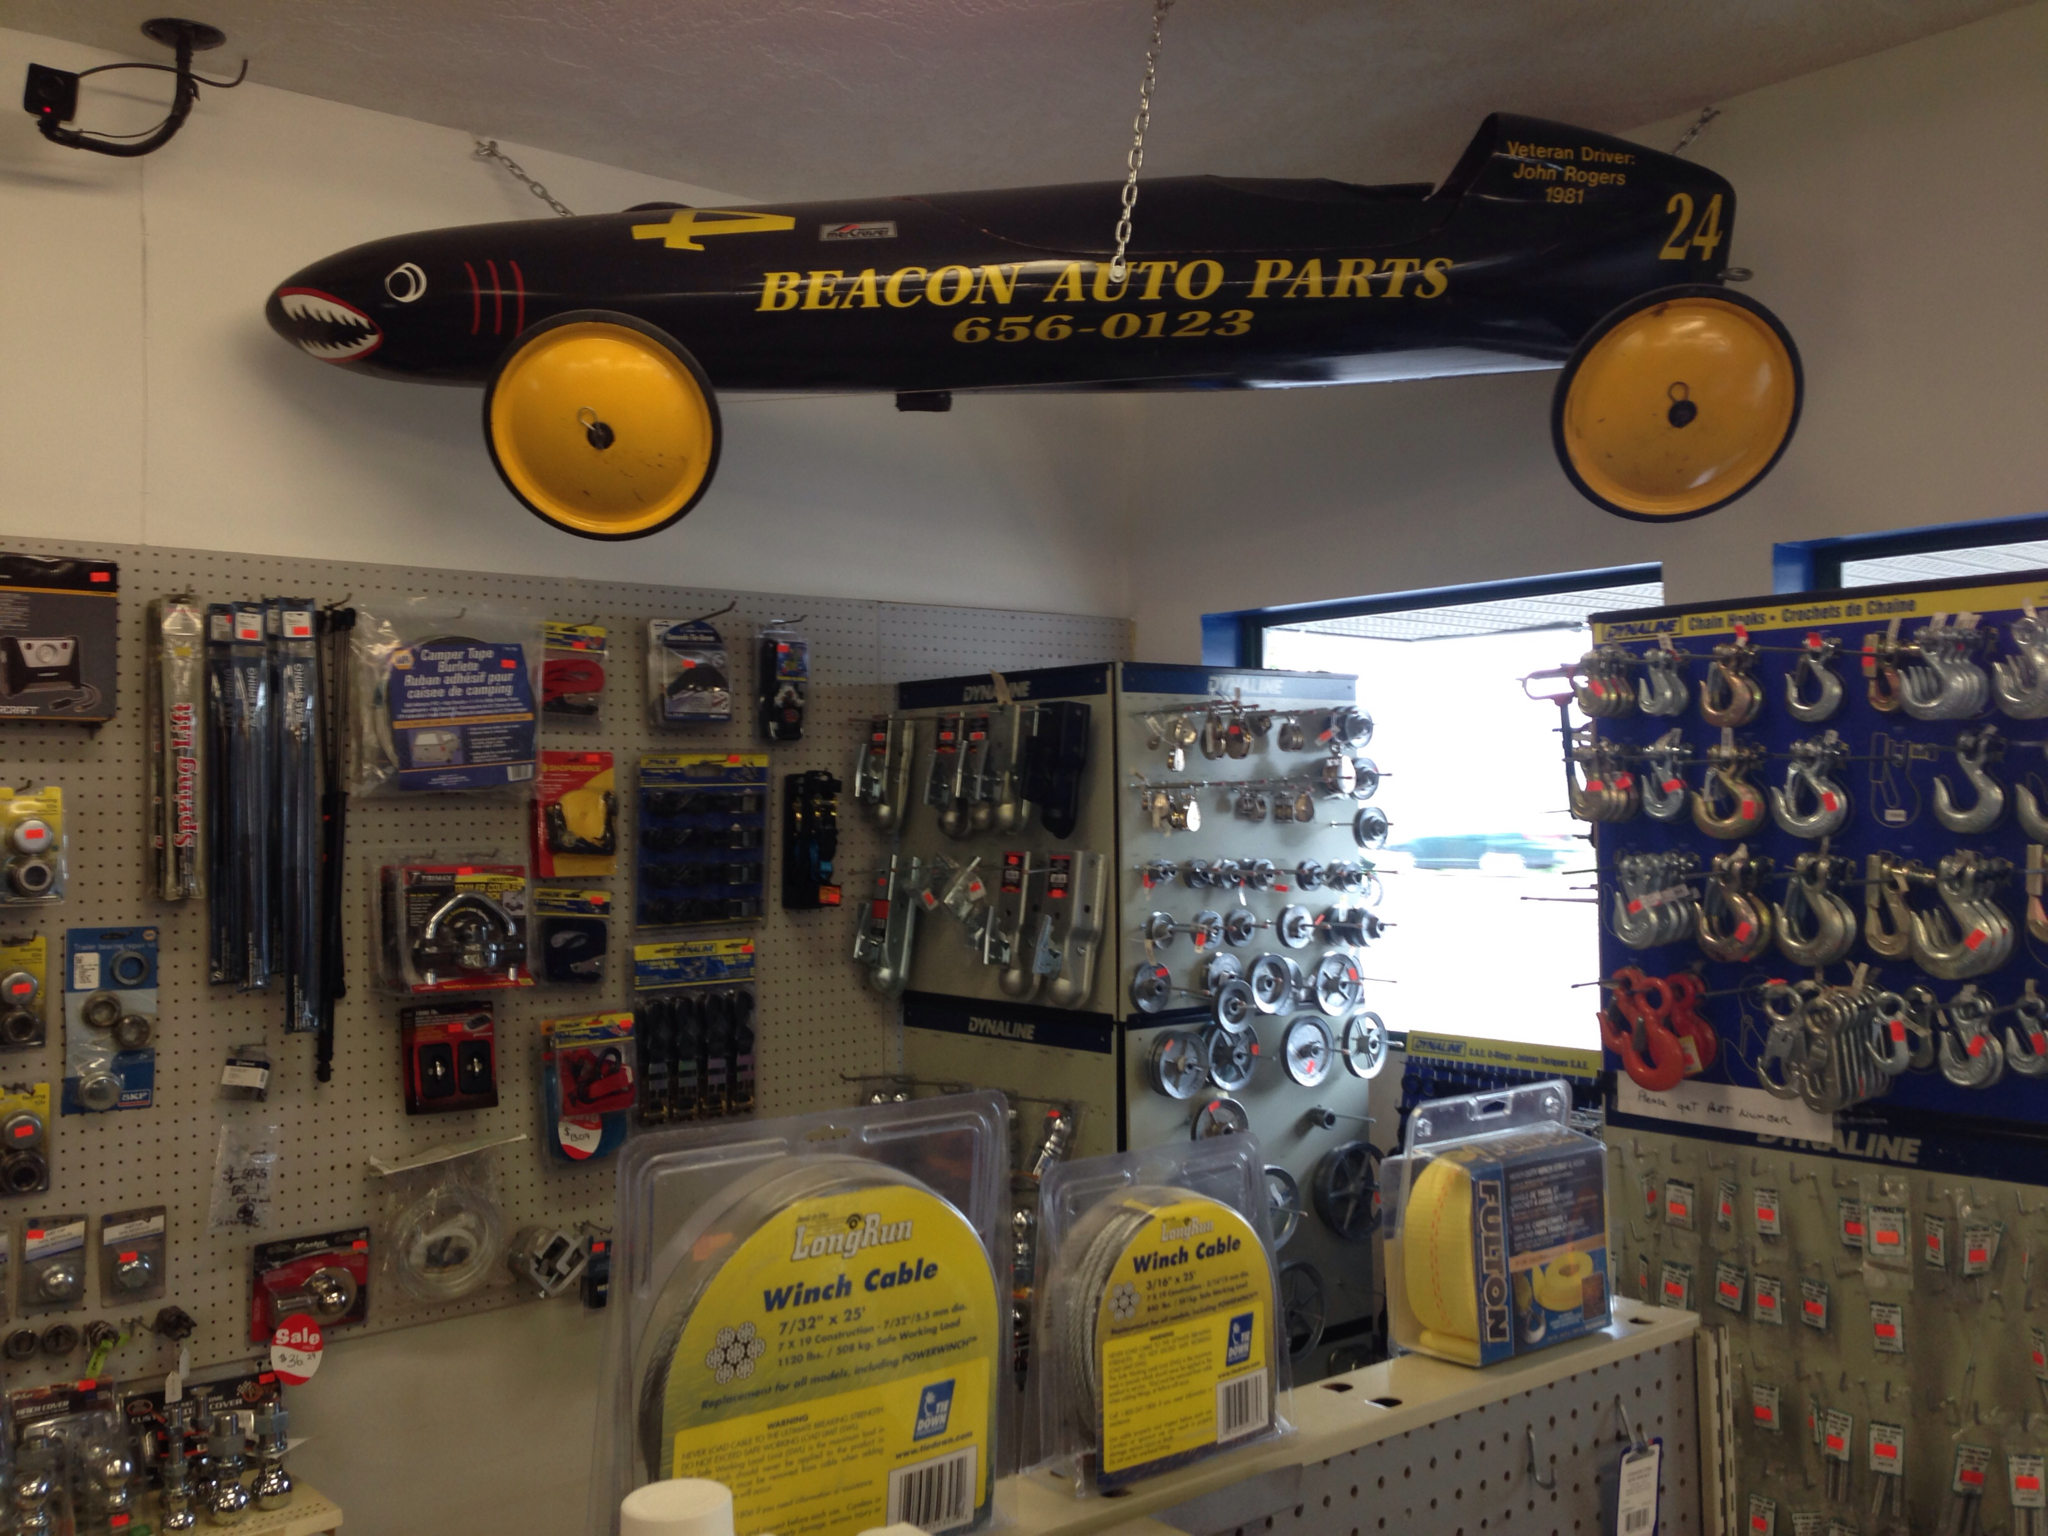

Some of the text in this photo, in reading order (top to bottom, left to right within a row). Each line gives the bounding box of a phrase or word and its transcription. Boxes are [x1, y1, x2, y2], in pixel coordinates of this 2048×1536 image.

[1507, 142, 1635, 165] Veteran Driver:
[1513, 163, 1626, 187] John Rogers
[1545, 186, 1584, 204] 1981
[1658, 192, 1723, 260] 24
[755, 257, 1453, 311] BEACON AUTO PARTS
[953, 309, 1254, 342] 656-0123
[1688, 614, 1723, 631] Chain
[1781, 604, 1842, 622] Crochets
[1846, 603, 1862, 617] de
[1607, 619, 1678, 640] DYNALINE
[421, 647, 495, 662] Camper Tape
[404, 674, 442, 687] Ruban
[487, 672, 514, 685] pour
[448, 685, 463, 697] de
[466, 683, 514, 697] camping
[170, 702, 199, 848] Spring Lift
[968, 1016, 1035, 1041] DYNALINE
[1413, 1039, 1465, 1054] DYNALINE
[121, 1091, 148, 1101] SKF
[1757, 1129, 1922, 1164] ALINE
[791, 1213, 914, 1262] LongRun
[1160, 1217, 1214, 1242] LongRun
[295, 1239, 328, 1250] Master
[1132, 1235, 1241, 1274] Winch Cable
[1479, 1180, 1511, 1343] FULTON
[763, 1257, 939, 1313] Winch Cable
[779, 1314, 824, 1336] 7/32"
[843, 1306, 866, 1322] 25'
[900, 1326, 938, 1341] Working
[940, 1318, 961, 1331] Load
[275, 1327, 321, 1345] Sale
[815, 1325, 875, 1345] Construction
[701, 1386, 772, 1410] Replacement
[775, 1382, 790, 1393] for
[854, 1358, 899, 1375] including
[209, 1398, 243, 1411] COVER
[936, 1400, 949, 1414] TIE
[917, 1413, 948, 1431] DOWN
[896, 1431, 973, 1460] www.tiedown.com
